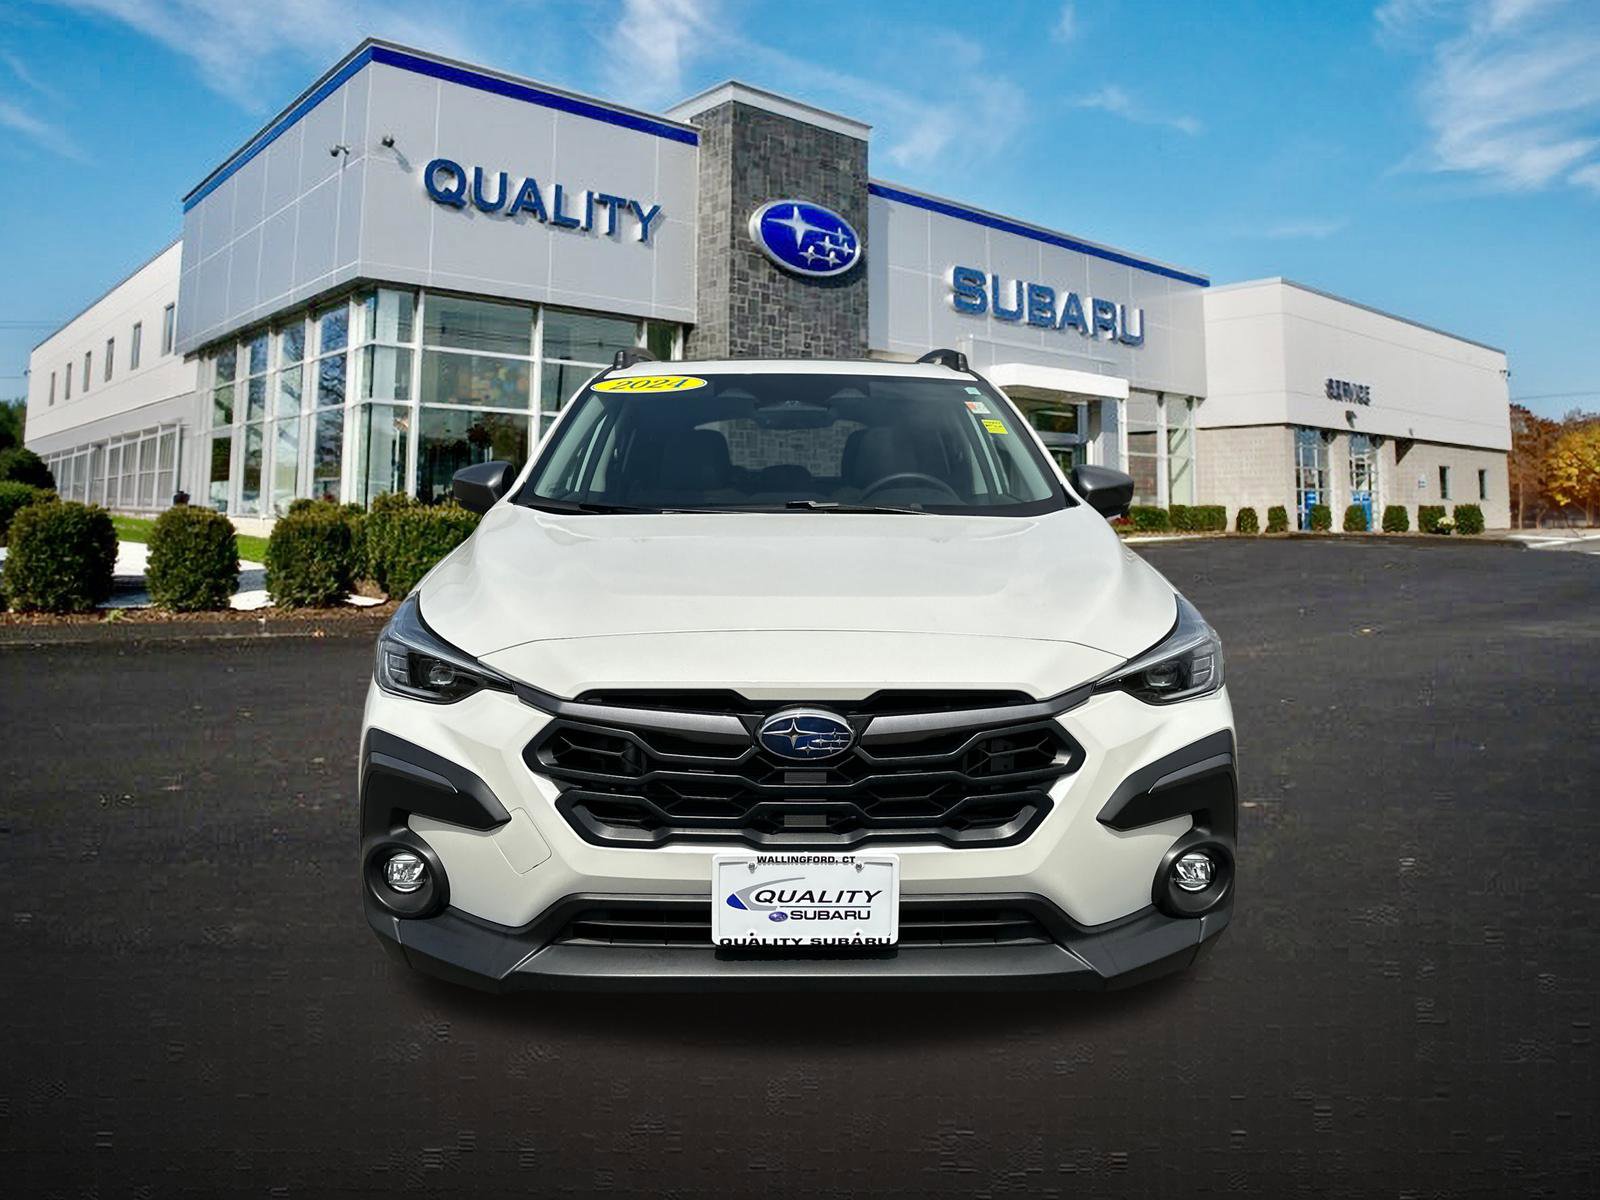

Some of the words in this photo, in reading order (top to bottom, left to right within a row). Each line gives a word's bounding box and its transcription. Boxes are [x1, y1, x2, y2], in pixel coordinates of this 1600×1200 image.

[424, 158, 661, 242] QUALITY
[946, 265, 1145, 346] SUBARU
[609, 379, 689, 390] 2024
[1325, 378, 1371, 406] SERVICE
[842, 855, 856, 864] CT
[754, 889, 883, 904] QUALITY
[790, 910, 871, 921] SUBARU
[719, 937, 803, 947] QUALITY
[810, 937, 891, 947] SUBARU
